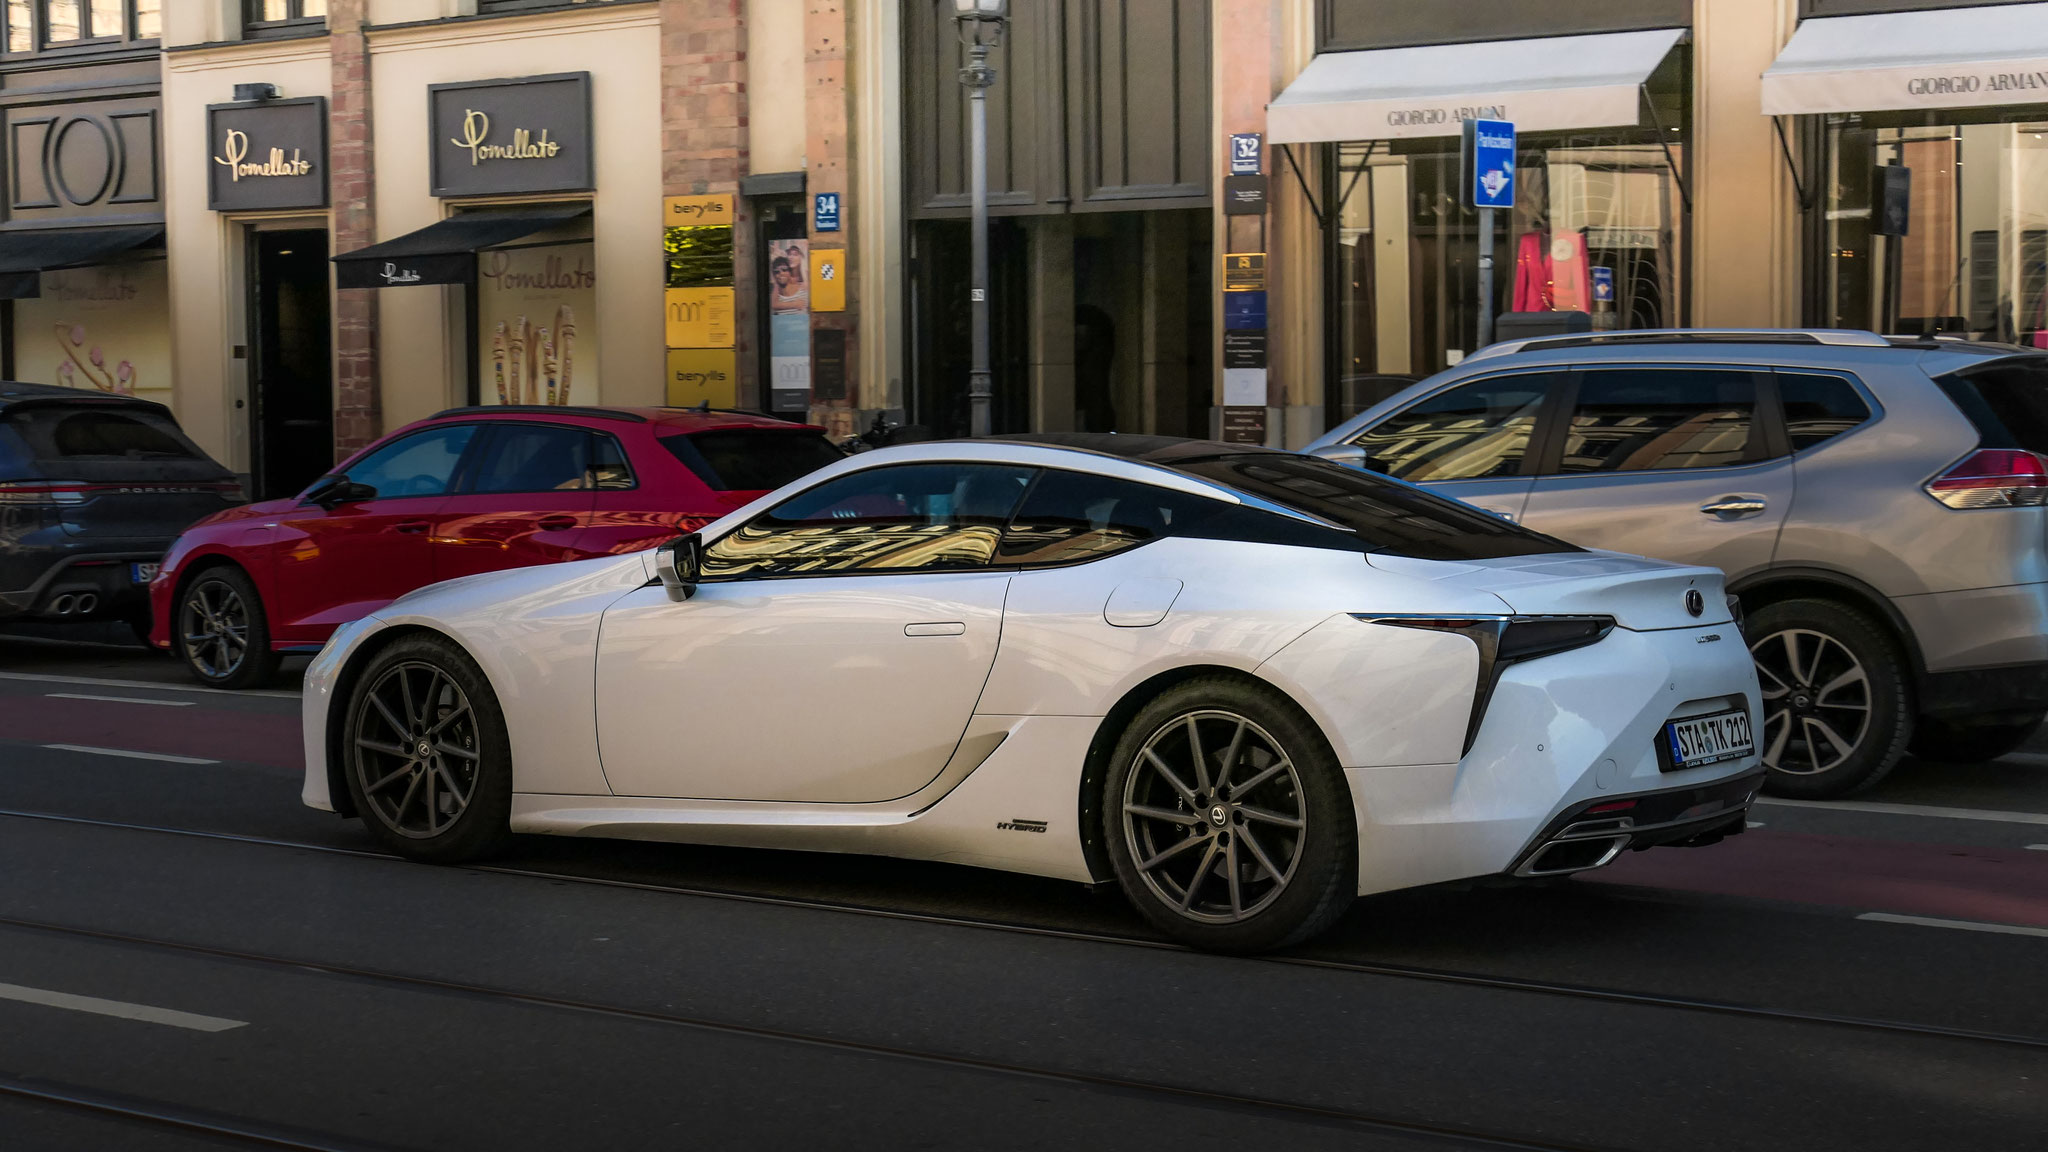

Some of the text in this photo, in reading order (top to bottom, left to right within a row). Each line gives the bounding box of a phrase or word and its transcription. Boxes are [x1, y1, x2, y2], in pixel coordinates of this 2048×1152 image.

[1907, 76, 1980, 95] GIORGIO
[1387, 105, 1506, 126] GIORGIO ARMNI
[450, 109, 560, 166] Pomellato
[1237, 137, 1259, 157] 32
[214, 128, 312, 182] Pomellato
[817, 196, 837, 214] 34
[483, 250, 594, 291] Pomellato
[1677, 716, 1750, 757] STA TK 212
[997, 822, 1047, 834] HYBRID
